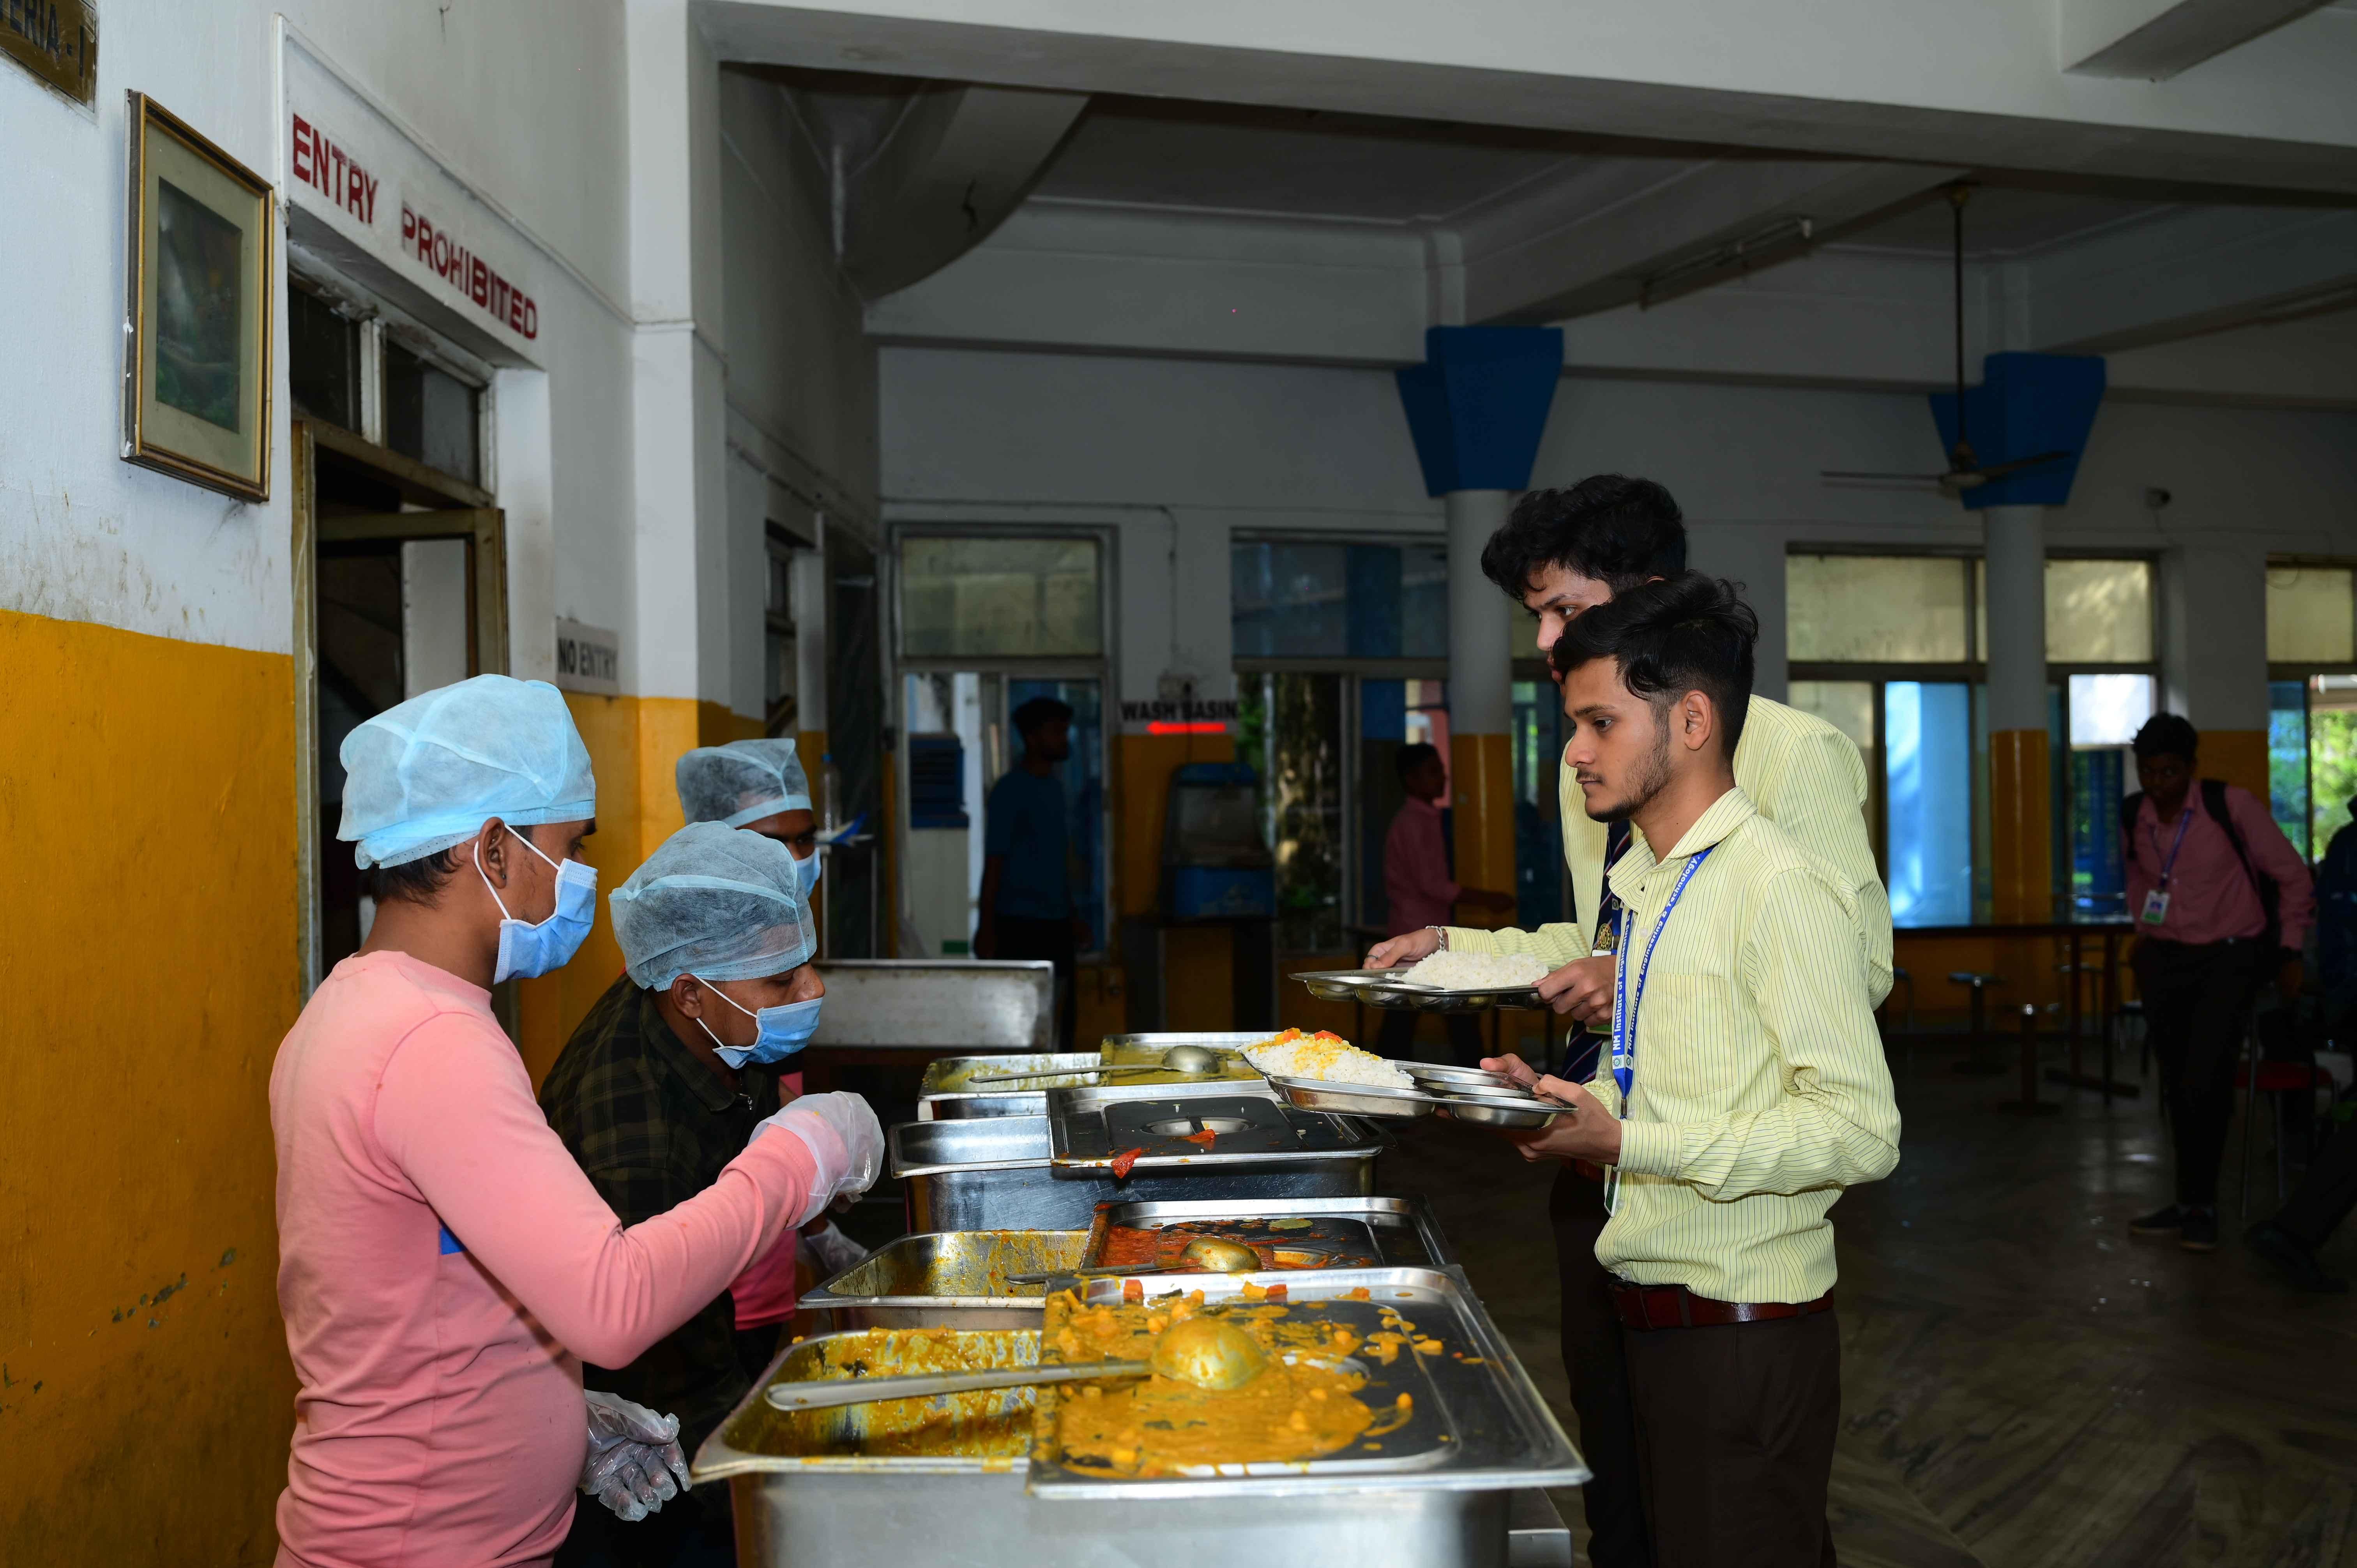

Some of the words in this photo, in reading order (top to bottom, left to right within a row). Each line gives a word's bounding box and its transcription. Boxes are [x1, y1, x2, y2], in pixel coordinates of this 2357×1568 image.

[293, 113, 378, 225] ENTRY
[401, 200, 537, 340] PROHIBITED
[558, 637, 576, 675] NO
[579, 642, 617, 681] ENTRY
[1120, 701, 1176, 720] WASH
[1618, 924, 1629, 978] Engineering
[1640, 920, 1663, 975] Engineering
[1618, 981, 1623, 991] of
[1638, 977, 1642, 989] of
[1614, 993, 1623, 1032] Institute
[1630, 992, 1640, 1031] Institute
[1613, 1034, 1621, 1051] NM
[1628, 1034, 1633, 1050] NM
